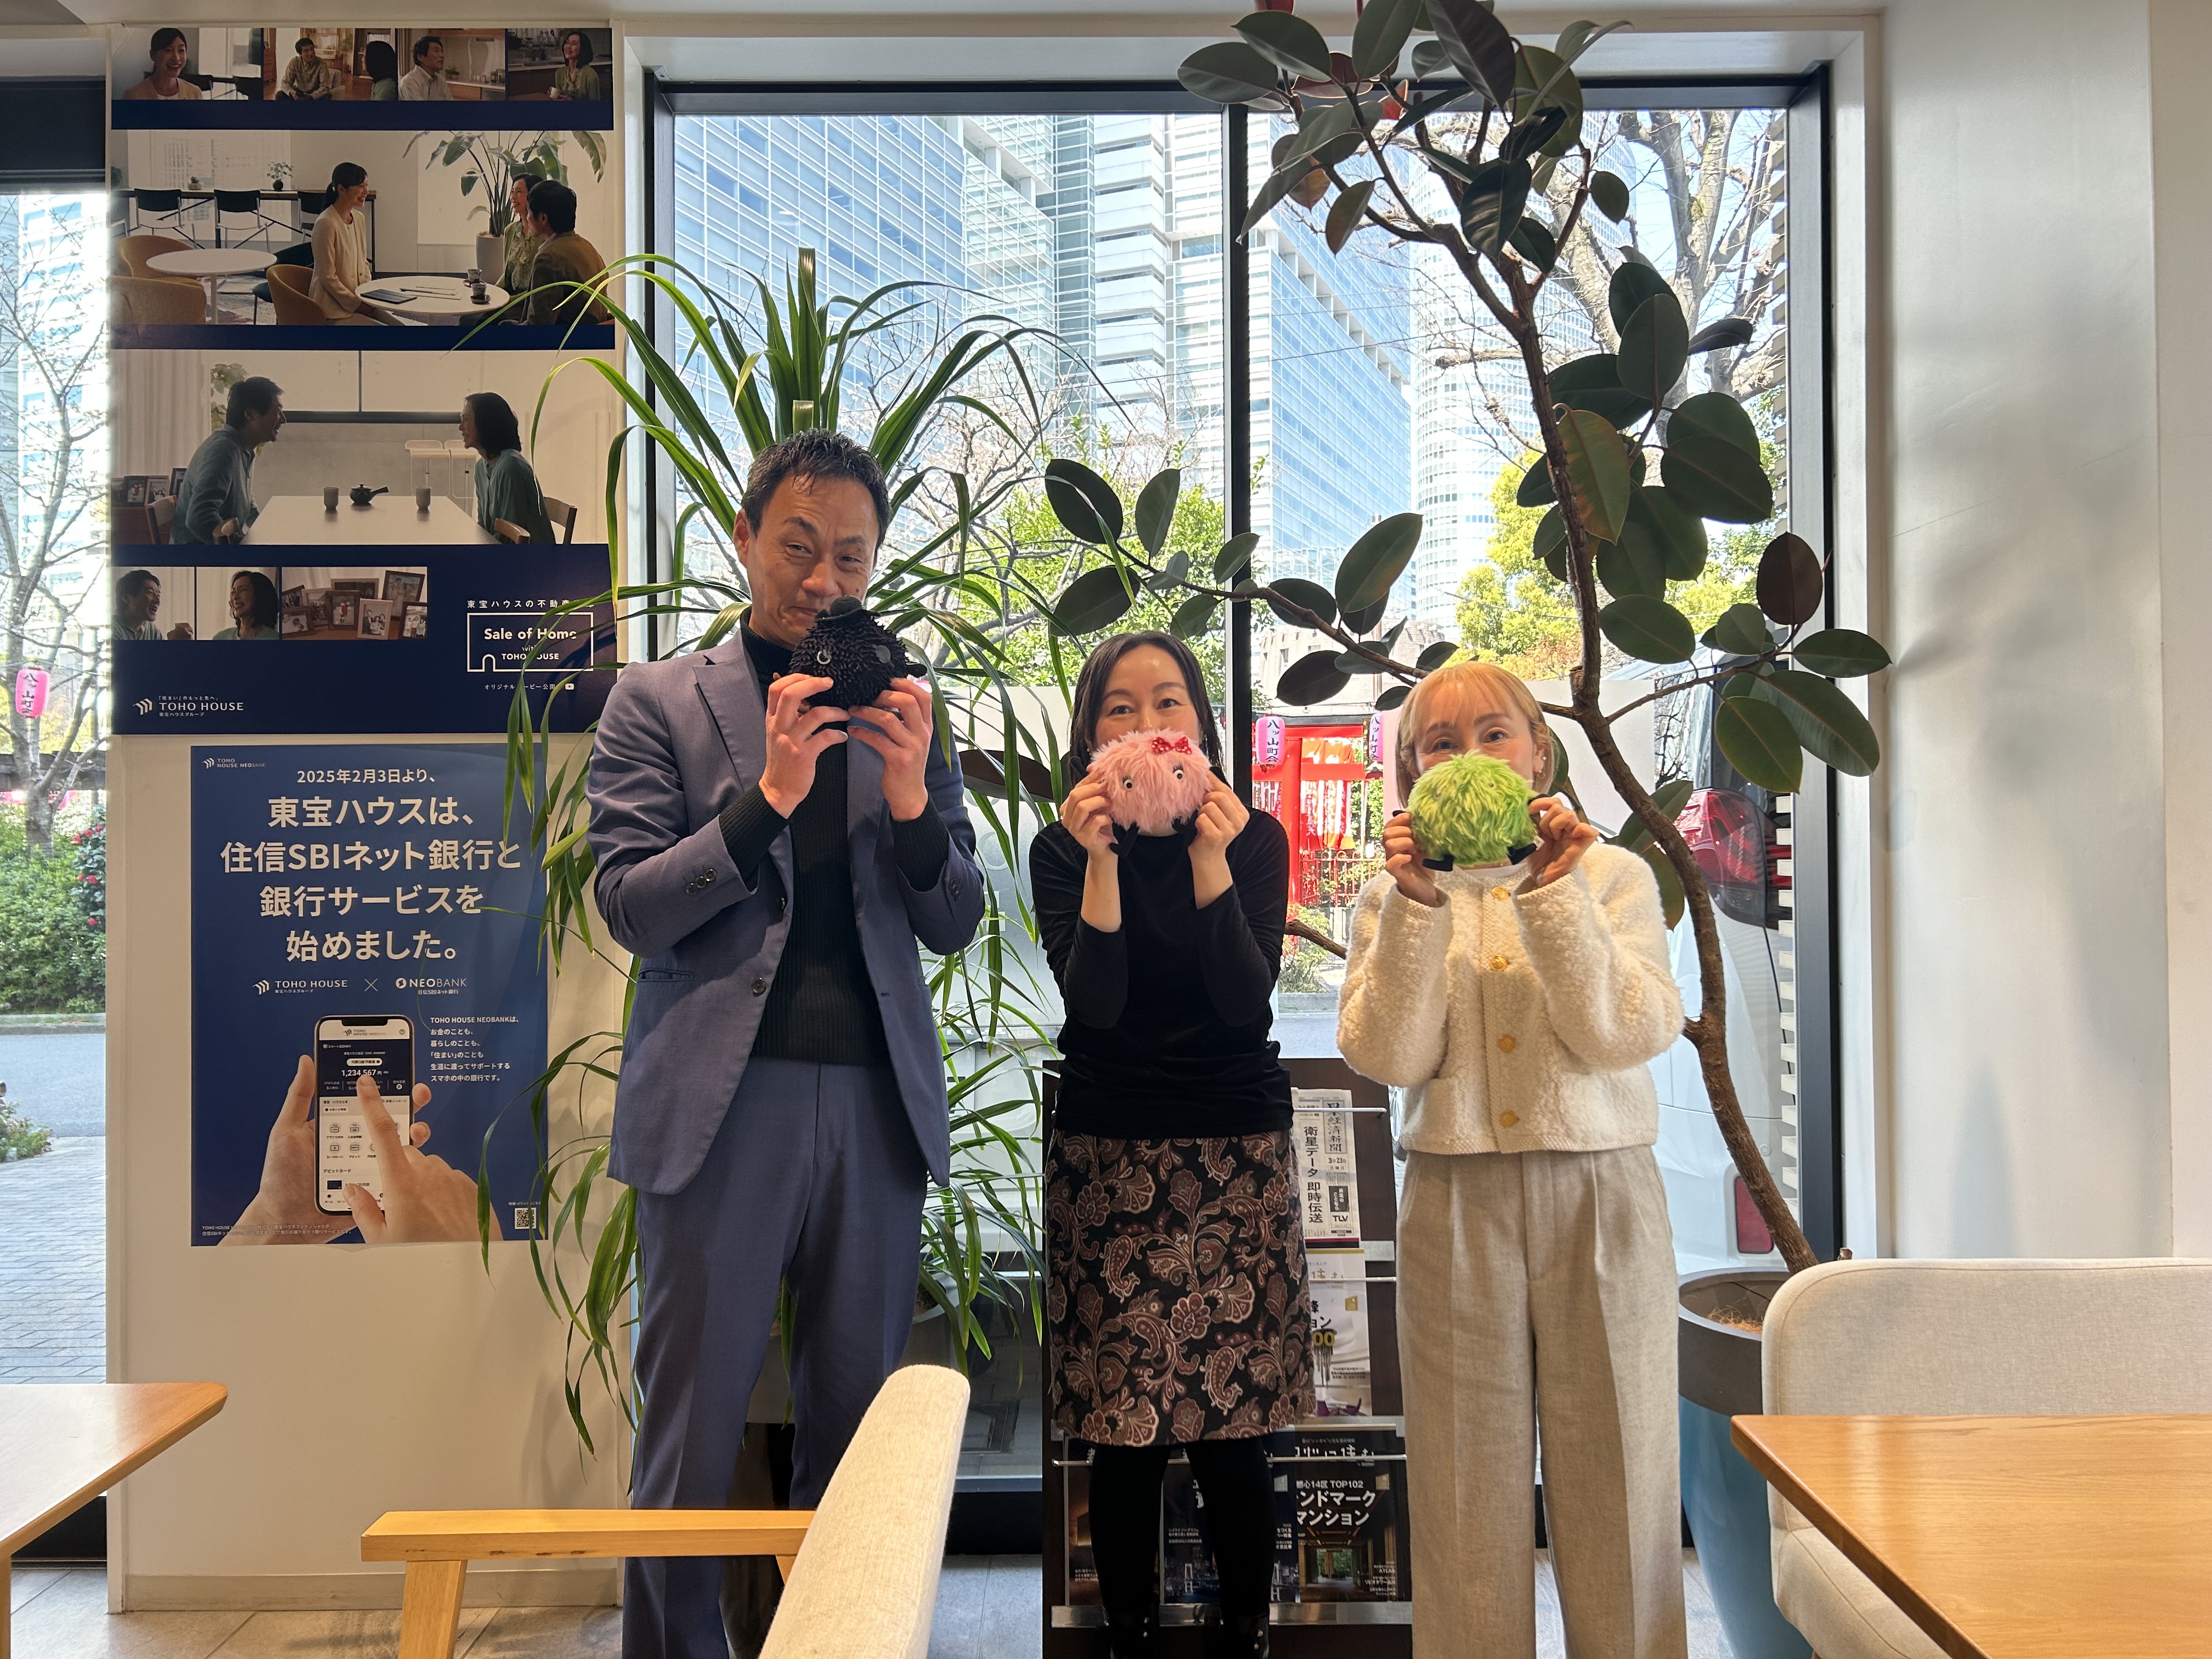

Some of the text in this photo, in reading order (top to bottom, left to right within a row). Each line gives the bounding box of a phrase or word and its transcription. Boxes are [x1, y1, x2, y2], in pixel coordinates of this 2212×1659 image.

[484, 628, 512, 640] Sale
[517, 628, 532, 640] of
[159, 702, 244, 711] TOHO HOUSE
[1265, 719, 1280, 762] 八ッ山町会
[297, 769, 436, 784] 2025年2月3日より、
[268, 795, 473, 828] 東宝ハウスは、
[220, 839, 521, 873] 住信SBIネット銀行と
[259, 884, 484, 917] 銀行サービスを
[286, 930, 456, 962] 始めました。
[275, 979, 348, 988] TOHO HOUSE
[409, 978, 467, 988] NEOBANK
[341, 1069, 376, 1077] 1,234,567
[1303, 1126, 1319, 1177] 衛星データ
[1307, 1182, 1324, 1223] 即時伝送
[1330, 1480, 1364, 1489] TOP102
[1296, 1490, 1376, 1508] ンドマーク
[1297, 1509, 1370, 1526] マンション
